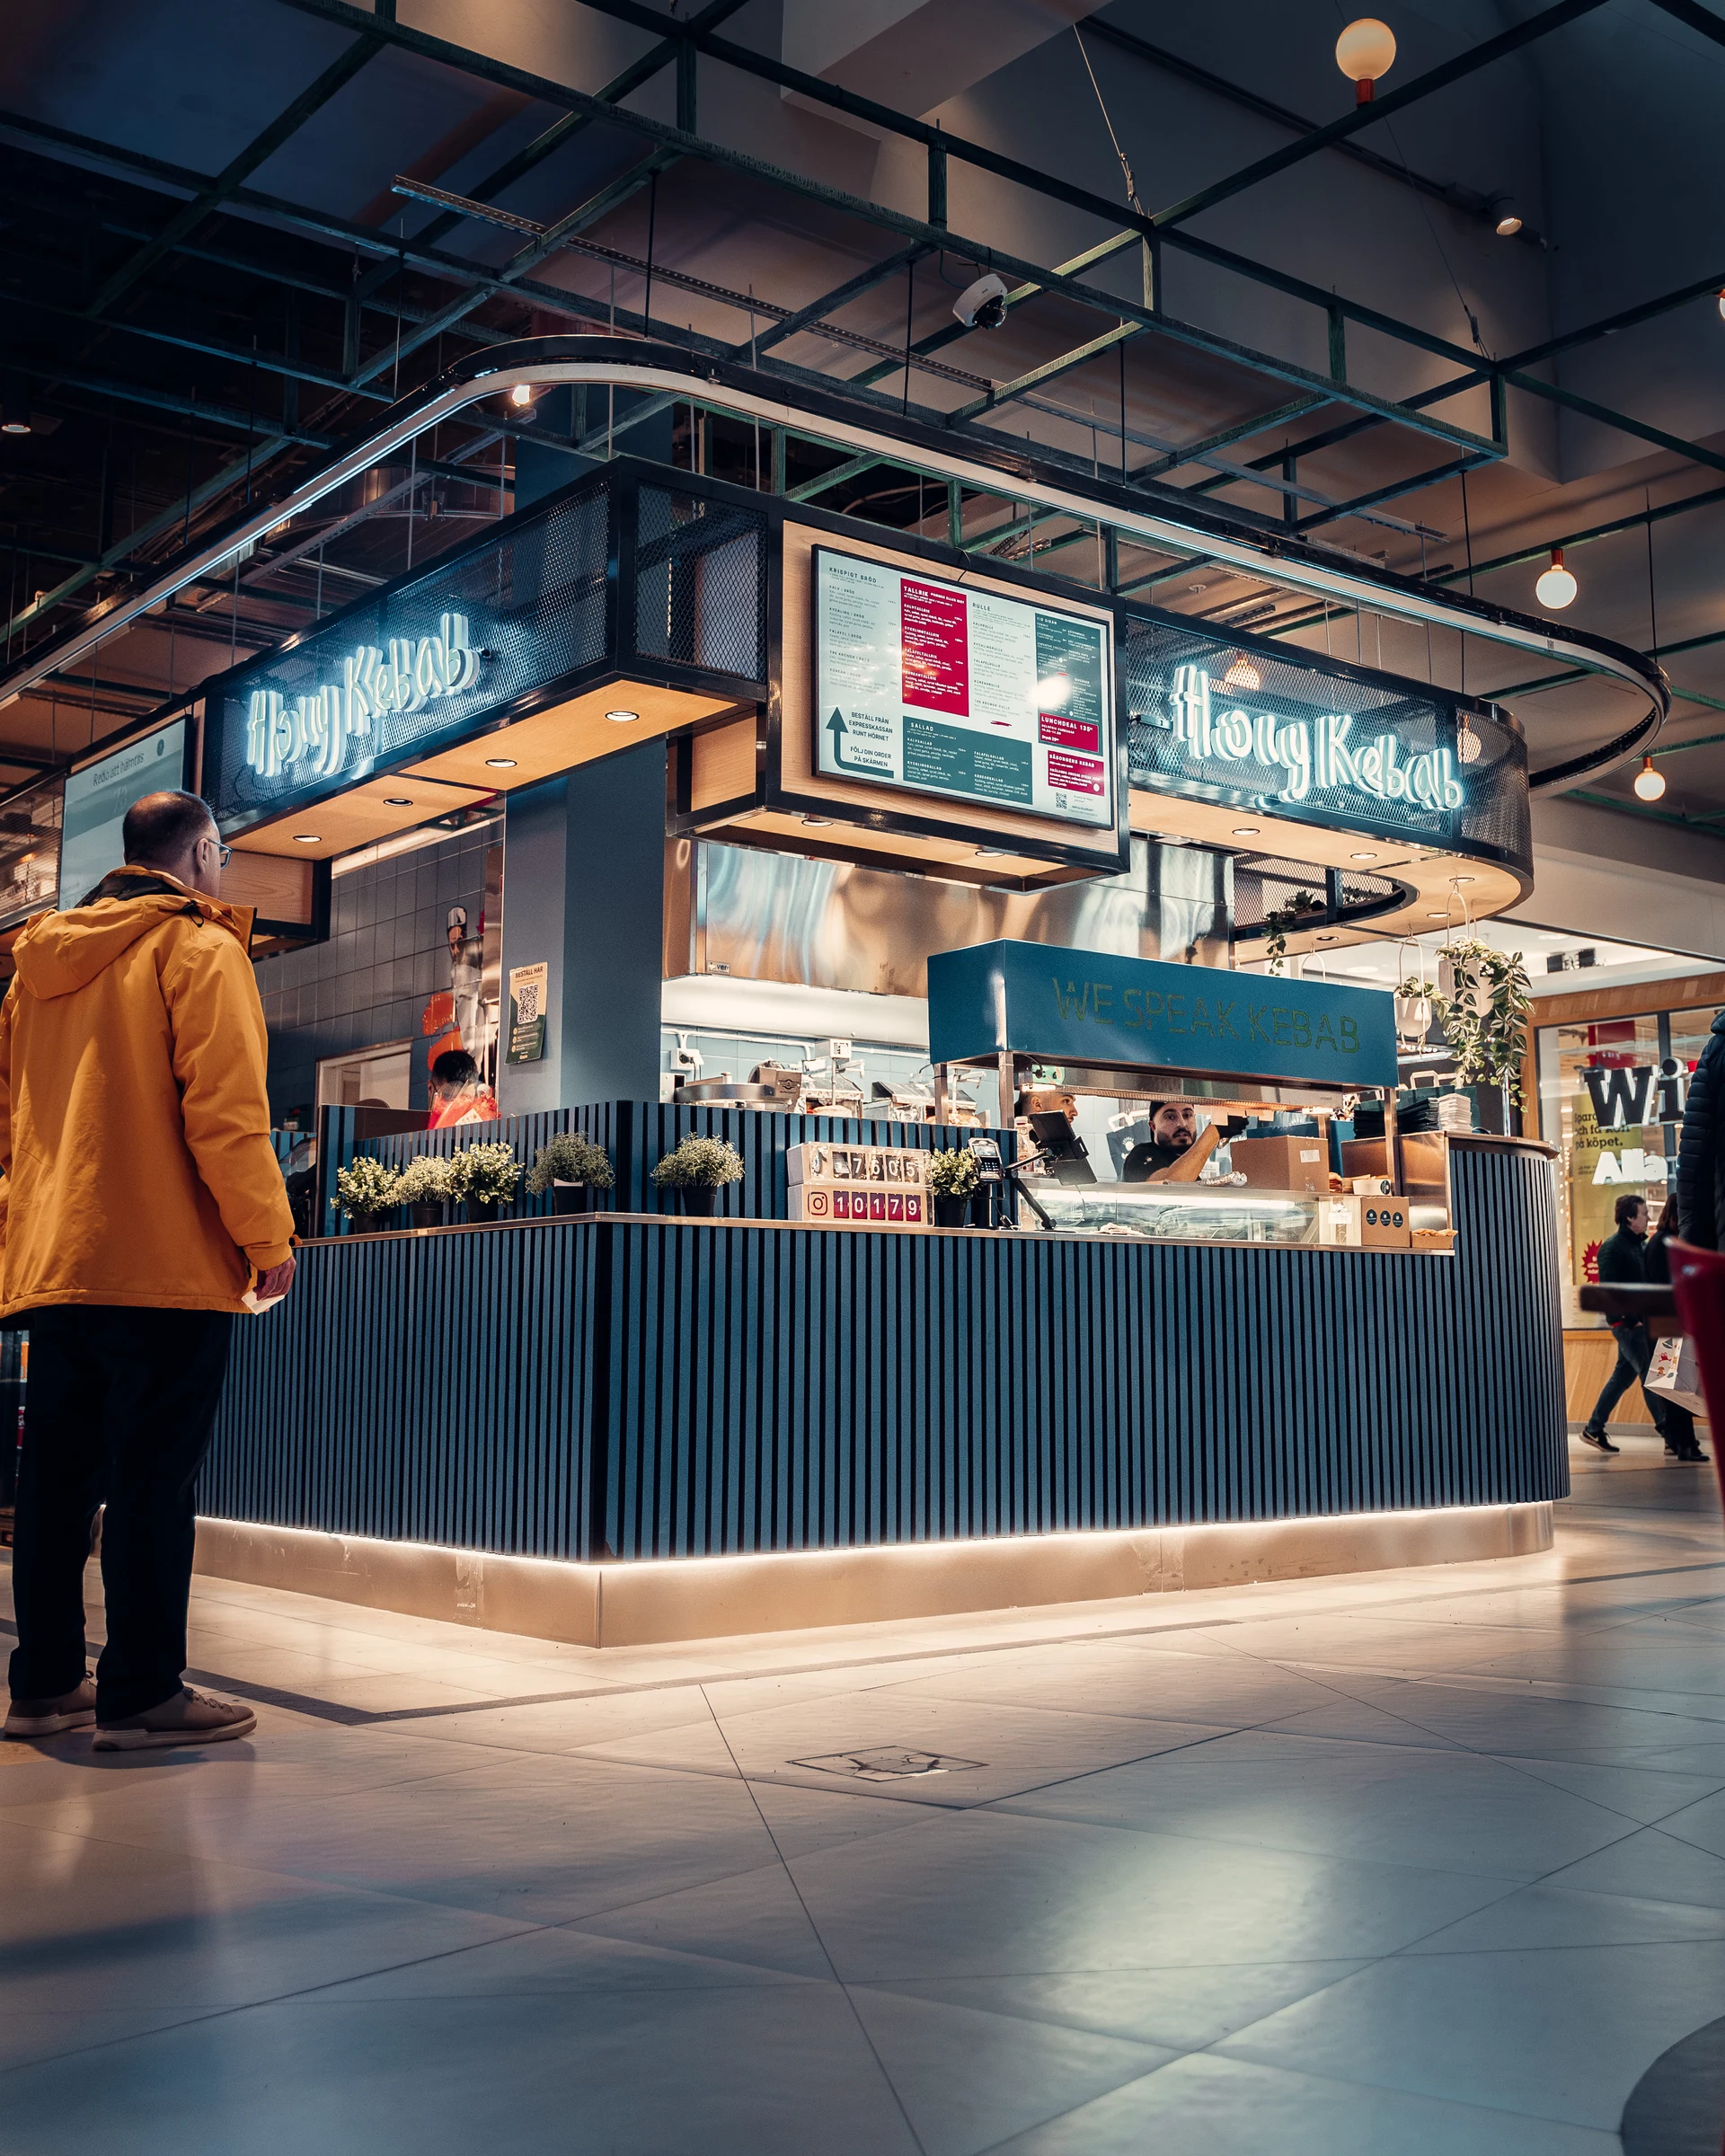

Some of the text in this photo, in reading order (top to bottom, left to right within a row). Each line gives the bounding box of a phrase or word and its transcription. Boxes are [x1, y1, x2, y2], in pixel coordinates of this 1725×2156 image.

[861, 574, 877, 583] BRÖD
[904, 586, 928, 596] TALLRIK
[973, 603, 991, 611] RULLE
[345, 613, 481, 738] Kebab
[852, 711, 889, 725] BESTÄLL FRÅN
[1041, 716, 1077, 729] LUNCHDEAL
[849, 720, 893, 734] EXPRESSKASSAN
[910, 722, 934, 731] SALLAD
[868, 731, 889, 741] HÖRNET
[850, 746, 863, 754] FÖLJ
[874, 751, 891, 759] ORDER
[862, 757, 889, 767] SKÄRMEN
[1314, 714, 1464, 810] Kebab
[93, 771, 110, 787] Redo
[119, 753, 145, 773] hämtas
[1052, 976, 1360, 1054] WE SPEAK KEBAB
[1586, 1136, 1623, 1149] köpet.
[1592, 1148, 1668, 1185] Alla
